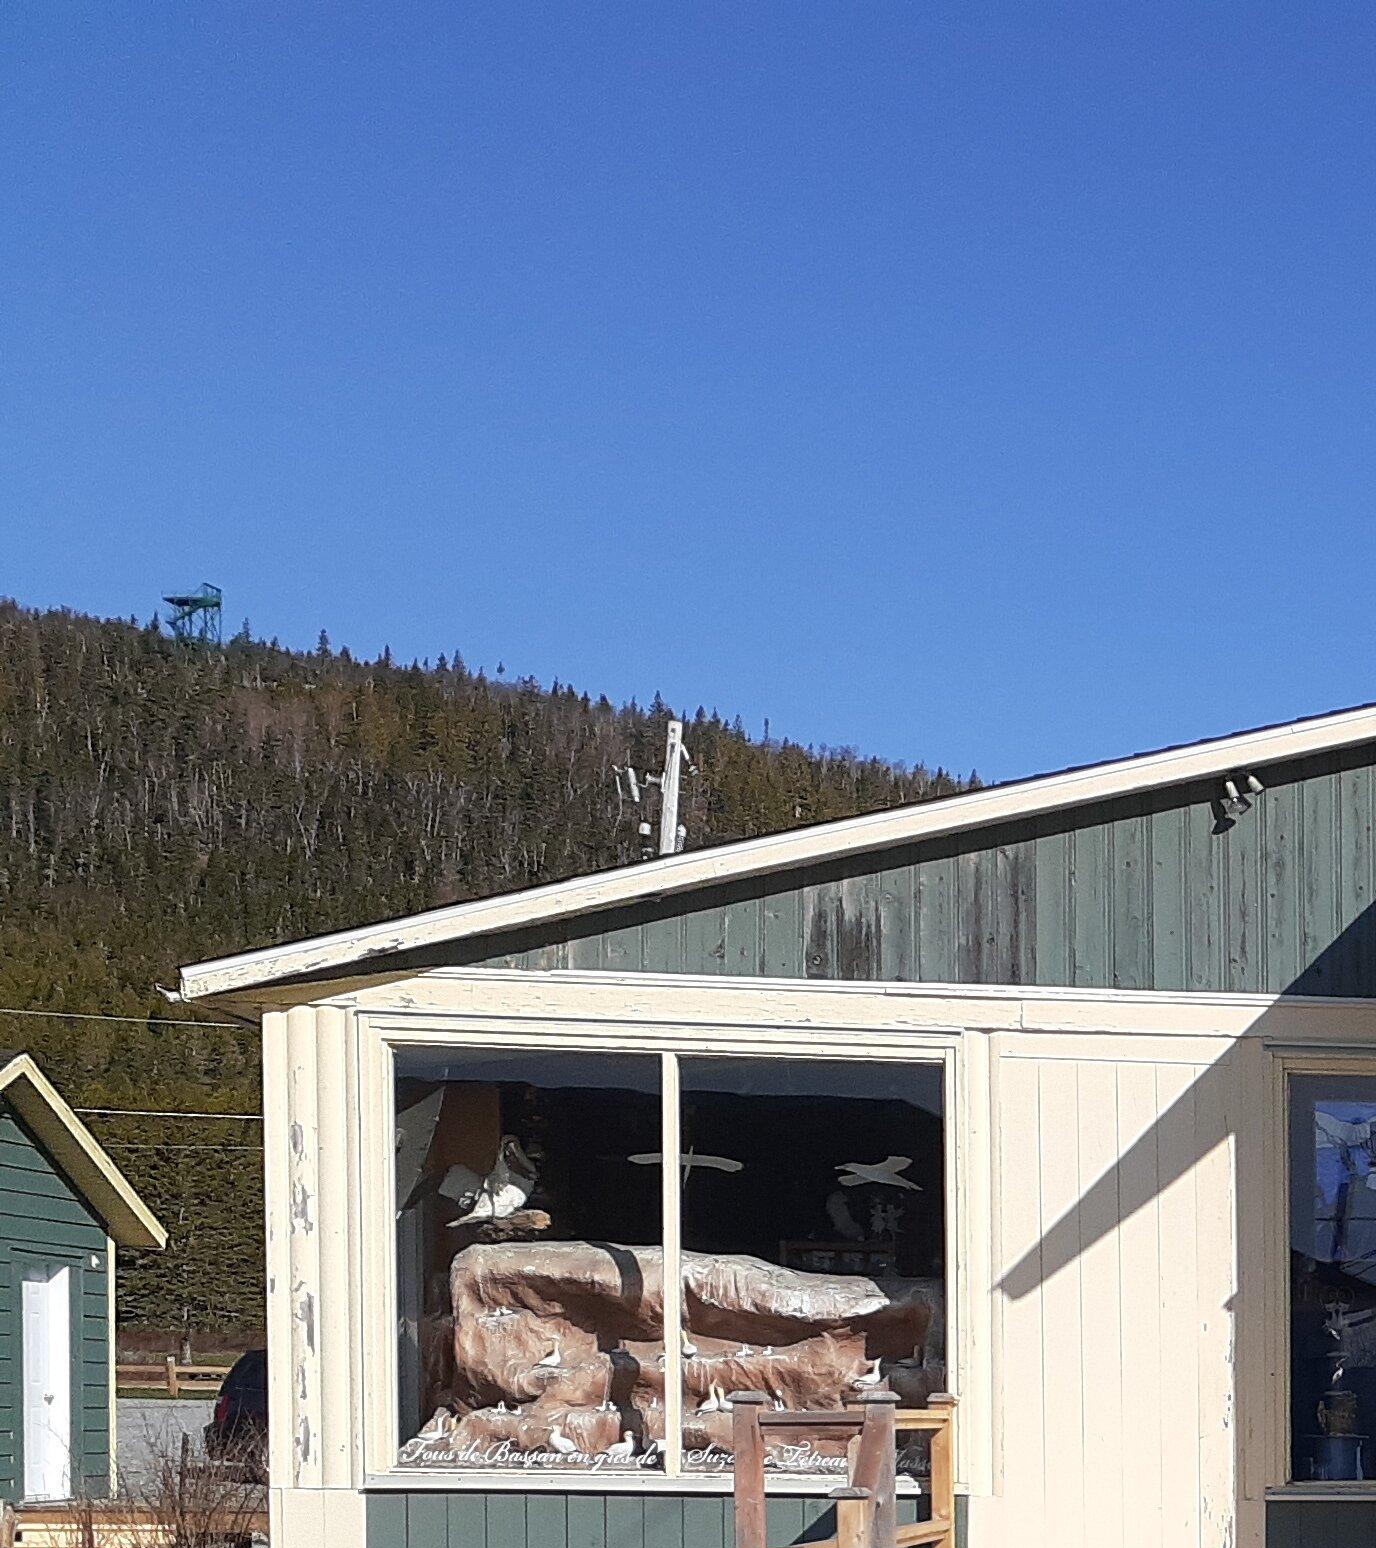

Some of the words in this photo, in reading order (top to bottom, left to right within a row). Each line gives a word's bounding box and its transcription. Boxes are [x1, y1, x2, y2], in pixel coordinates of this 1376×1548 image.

[402, 1437, 454, 1462] Fous
[457, 1438, 481, 1463] de
[484, 1437, 562, 1467] Bassan
[567, 1451, 596, 1464] en
[636, 1442, 658, 1468] de
